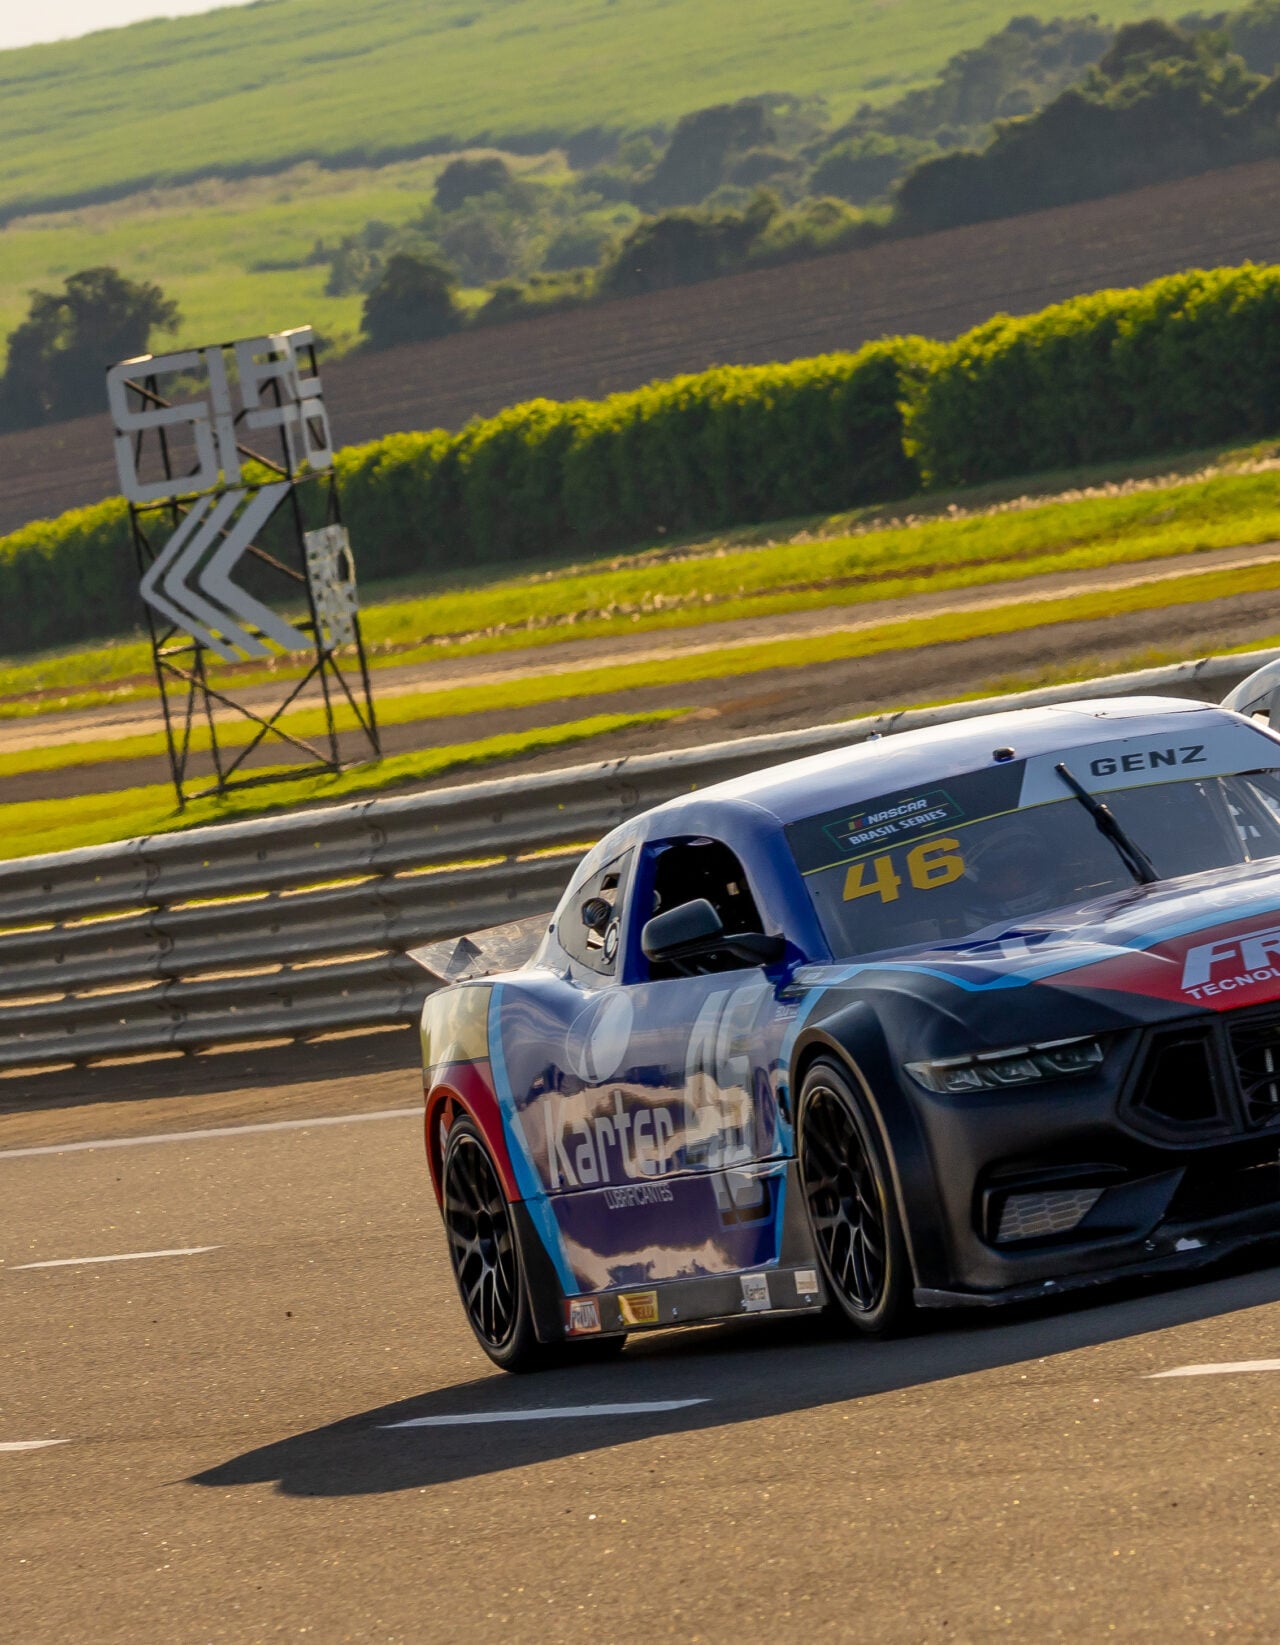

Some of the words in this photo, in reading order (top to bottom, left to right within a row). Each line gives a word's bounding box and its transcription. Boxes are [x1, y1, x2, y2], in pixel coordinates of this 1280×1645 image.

[1091, 745, 1208, 777] GENZ
[848, 824, 901, 845] BRASIL
[899, 809, 948, 829] SERIES
[866, 799, 928, 824] NASCAR
[843, 837, 966, 903] 46
